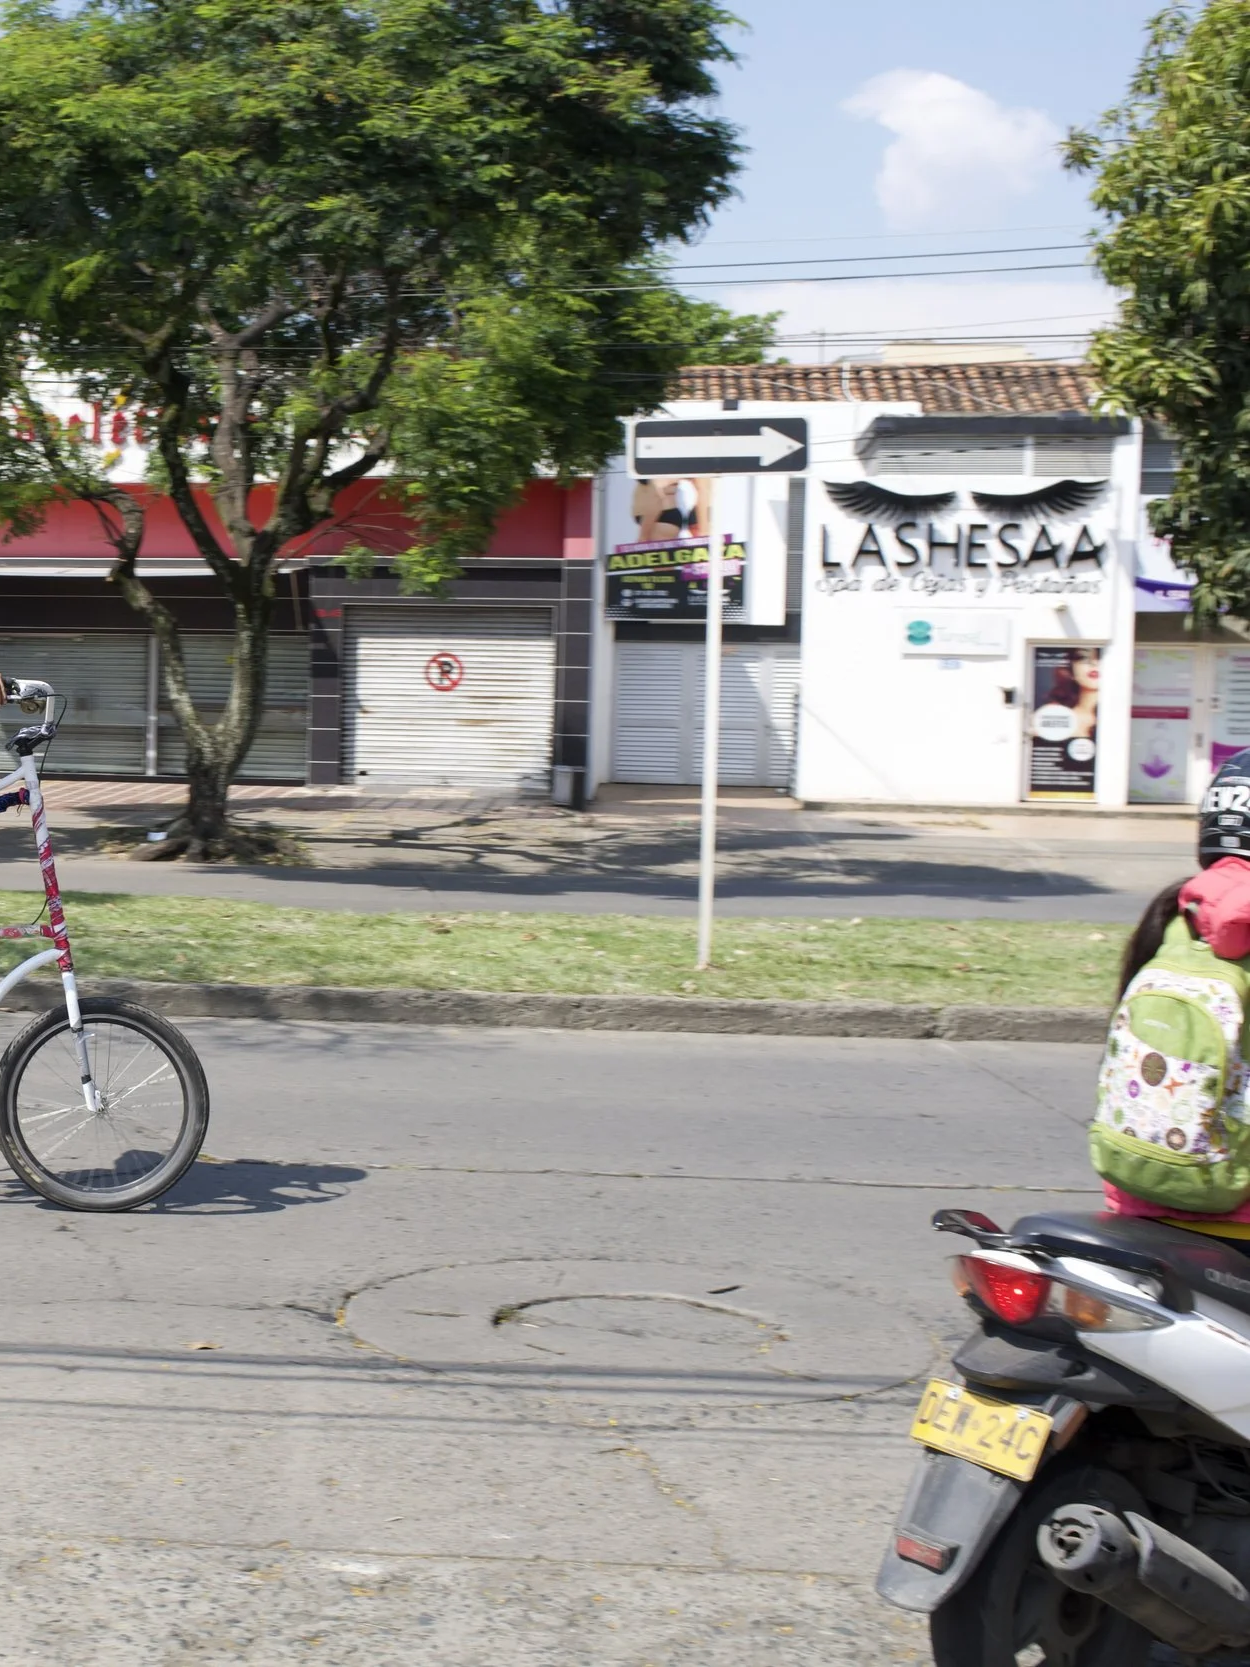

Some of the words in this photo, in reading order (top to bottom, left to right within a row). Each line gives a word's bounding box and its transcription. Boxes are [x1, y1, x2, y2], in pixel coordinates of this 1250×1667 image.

[608, 542, 747, 571] ADELGAA
[821, 522, 1105, 569] LASHESAA
[871, 571, 900, 592] de
[909, 570, 967, 597] Cejas
[974, 577, 989, 598] y
[999, 571, 1103, 594] Pestañas
